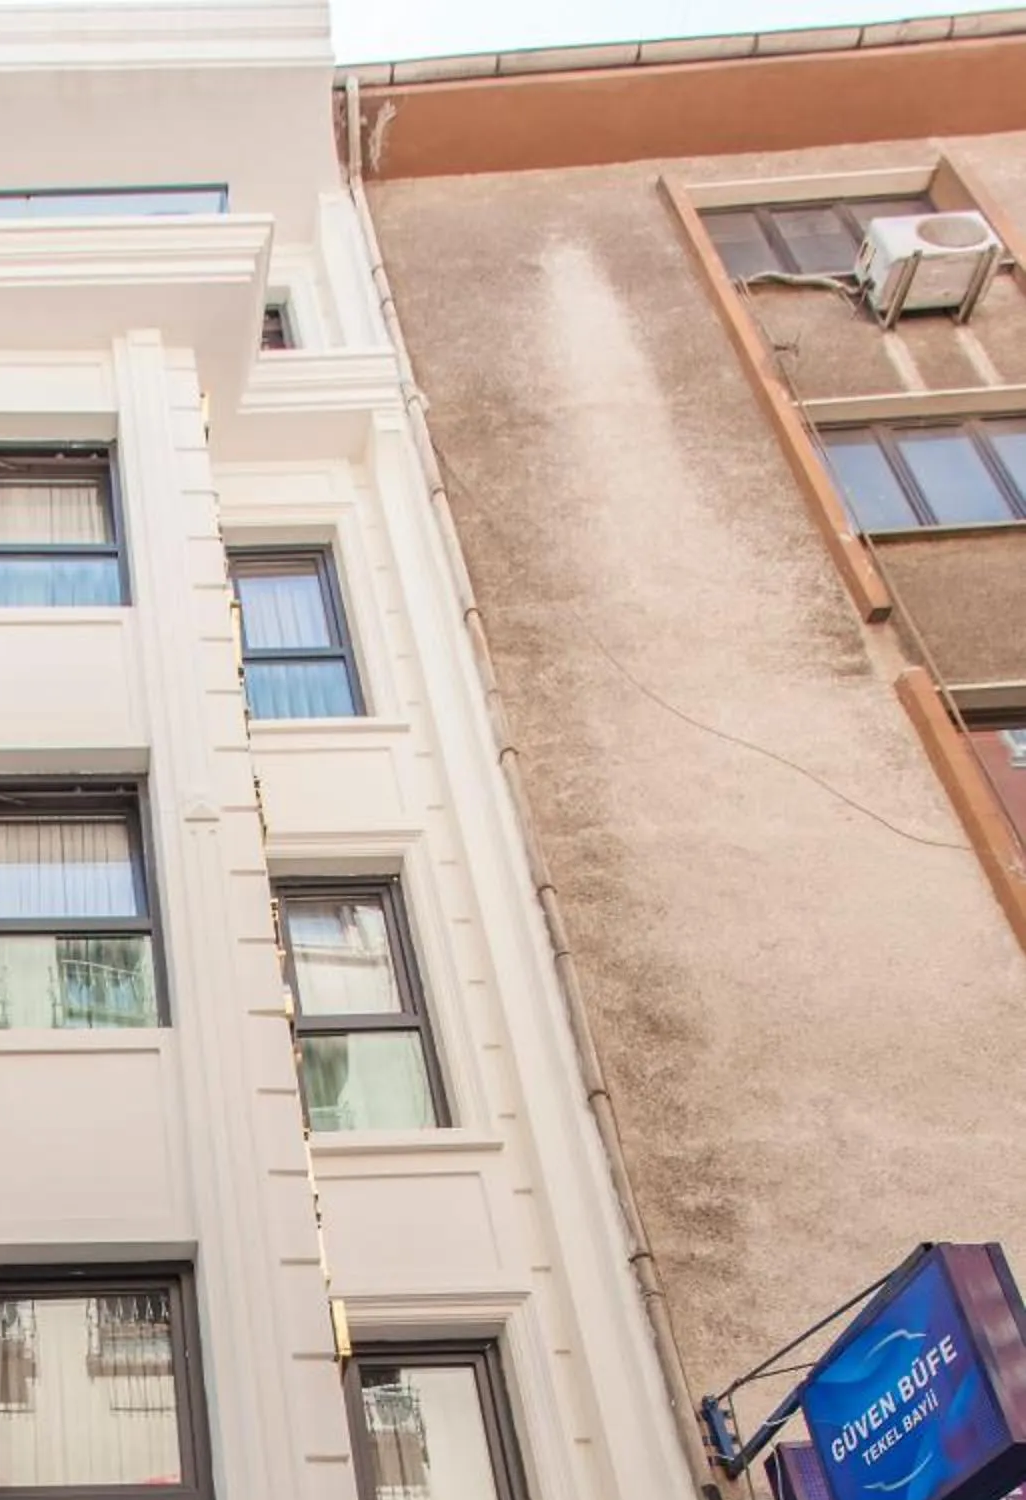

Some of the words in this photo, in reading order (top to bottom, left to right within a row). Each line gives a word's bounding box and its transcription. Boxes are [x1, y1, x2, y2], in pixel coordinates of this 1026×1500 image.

[831, 1391, 896, 1462] GÜVEN
[897, 1335, 957, 1403] BÜFE
[862, 1427, 903, 1466] TEKEL
